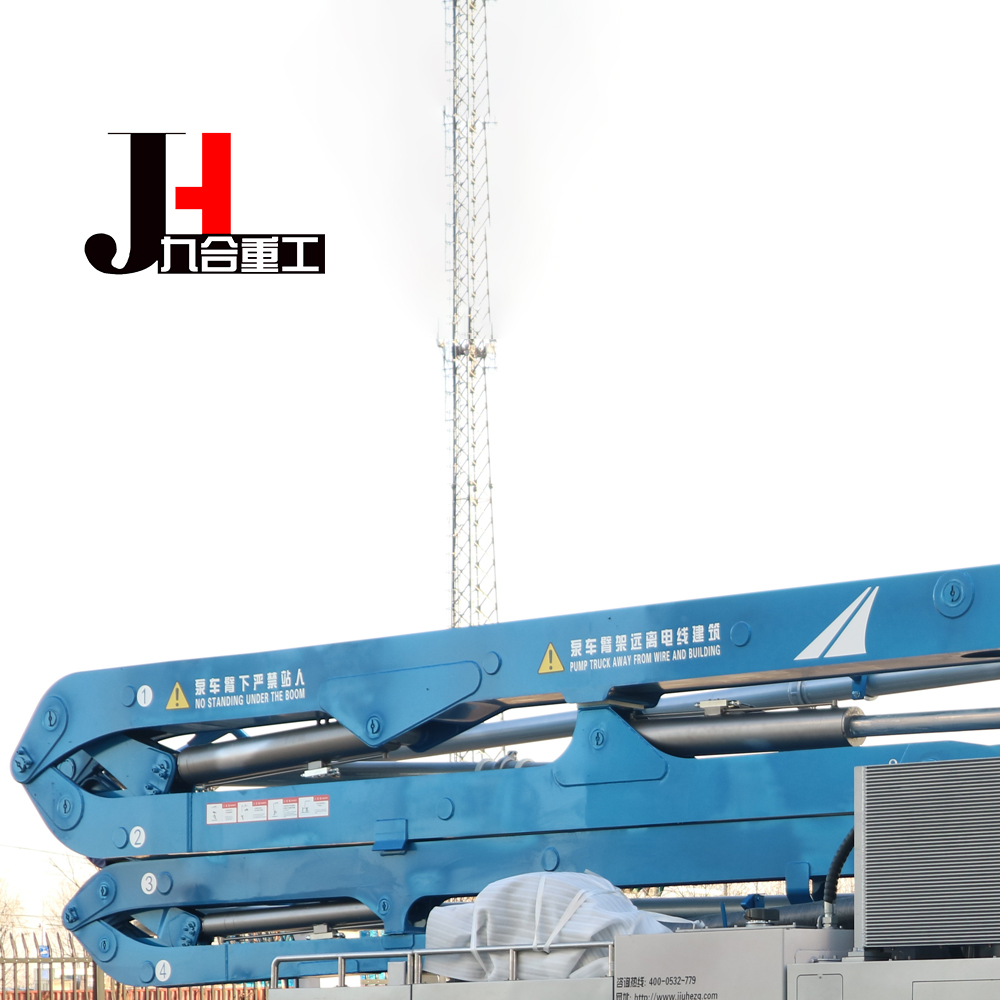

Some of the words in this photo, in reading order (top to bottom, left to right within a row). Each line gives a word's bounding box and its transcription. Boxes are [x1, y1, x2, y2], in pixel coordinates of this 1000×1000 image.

[569, 622, 721, 658] 泵车臂架远离电线建筑
[569, 661, 588, 673] PUMP
[589, 657, 611, 670] TRUCK
[612, 655, 632, 668] AWAY
[633, 653, 652, 665] FROM
[653, 650, 671, 663] WIRE
[672, 648, 687, 661] AND
[688, 644, 721, 659] BUILDING
[194, 668, 305, 696] 泵车臂下严禁站人
[194, 697, 206, 709] NO
[207, 694, 244, 708] STANDING
[245, 692, 269, 705] UNDER
[270, 690, 284, 702] THE
[284, 687, 306, 701] BOOM
[648, 975, 697, 987] 400-0532-779
